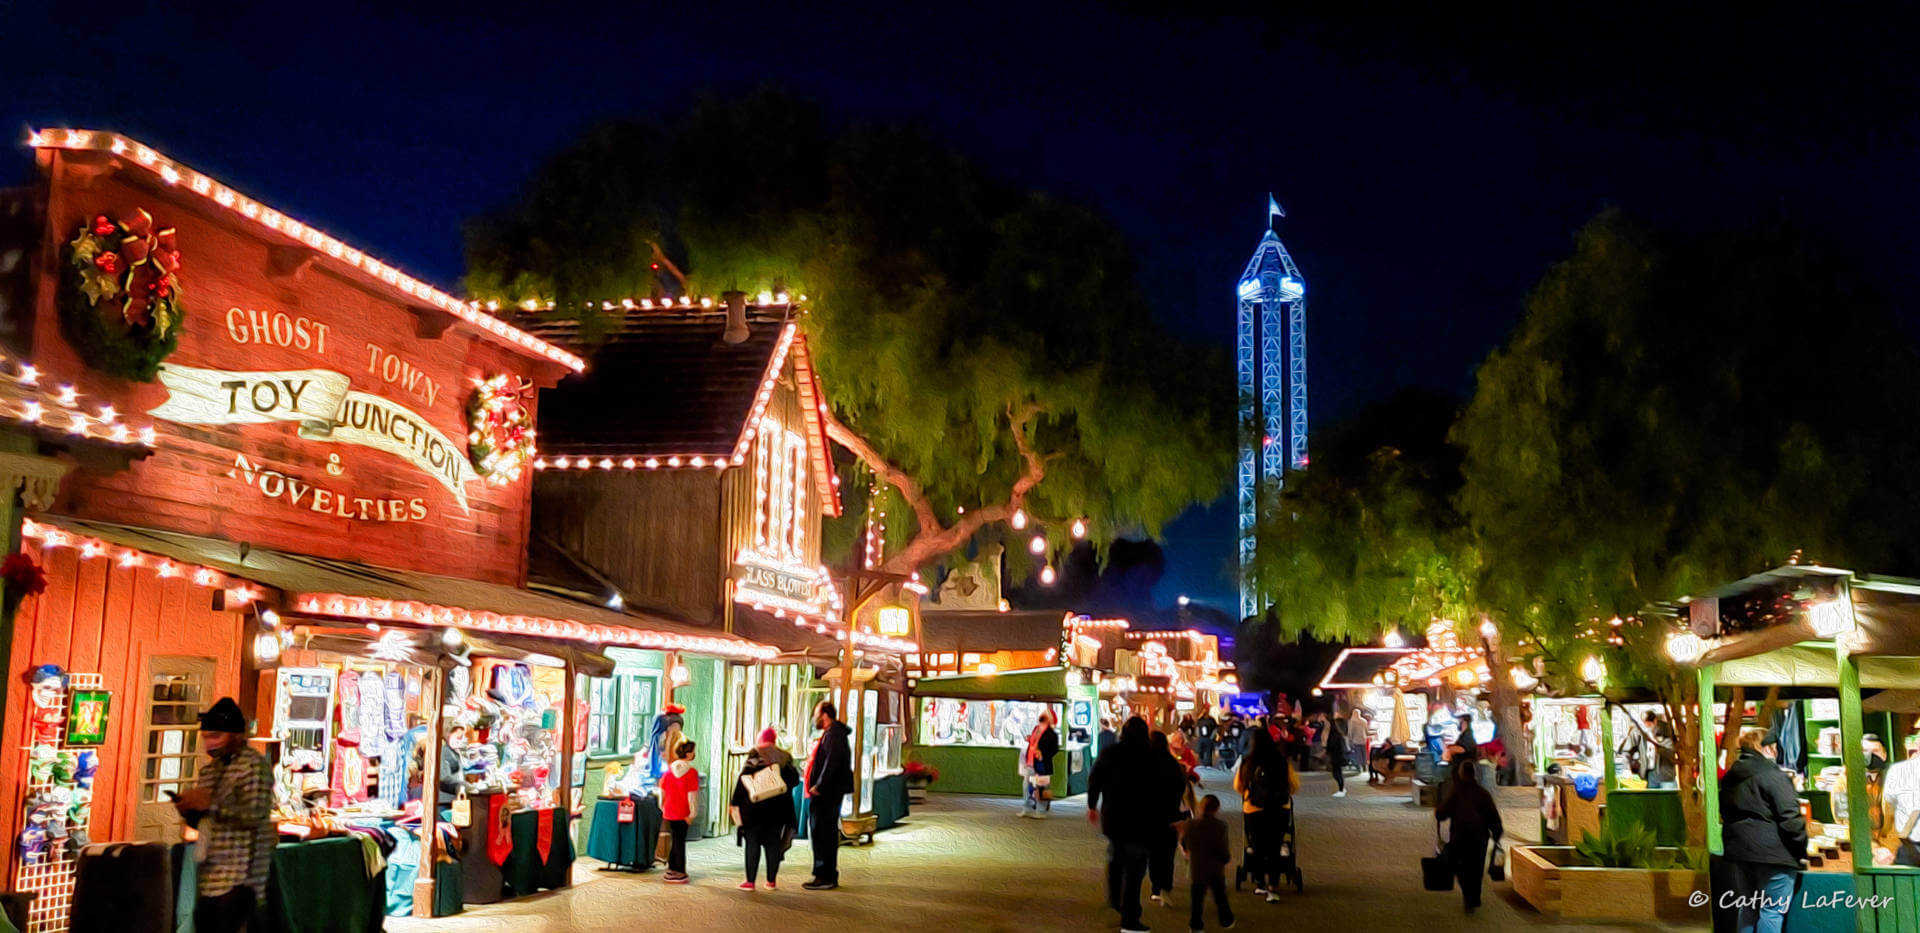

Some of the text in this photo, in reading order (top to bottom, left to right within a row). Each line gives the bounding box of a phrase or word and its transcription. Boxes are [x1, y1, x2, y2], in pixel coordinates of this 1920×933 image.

[226, 307, 440, 408] GHOST TOWN
[220, 379, 462, 489] TOY JUNCTION
[325, 452, 346, 477] &
[226, 453, 428, 523] NOVELTIES
